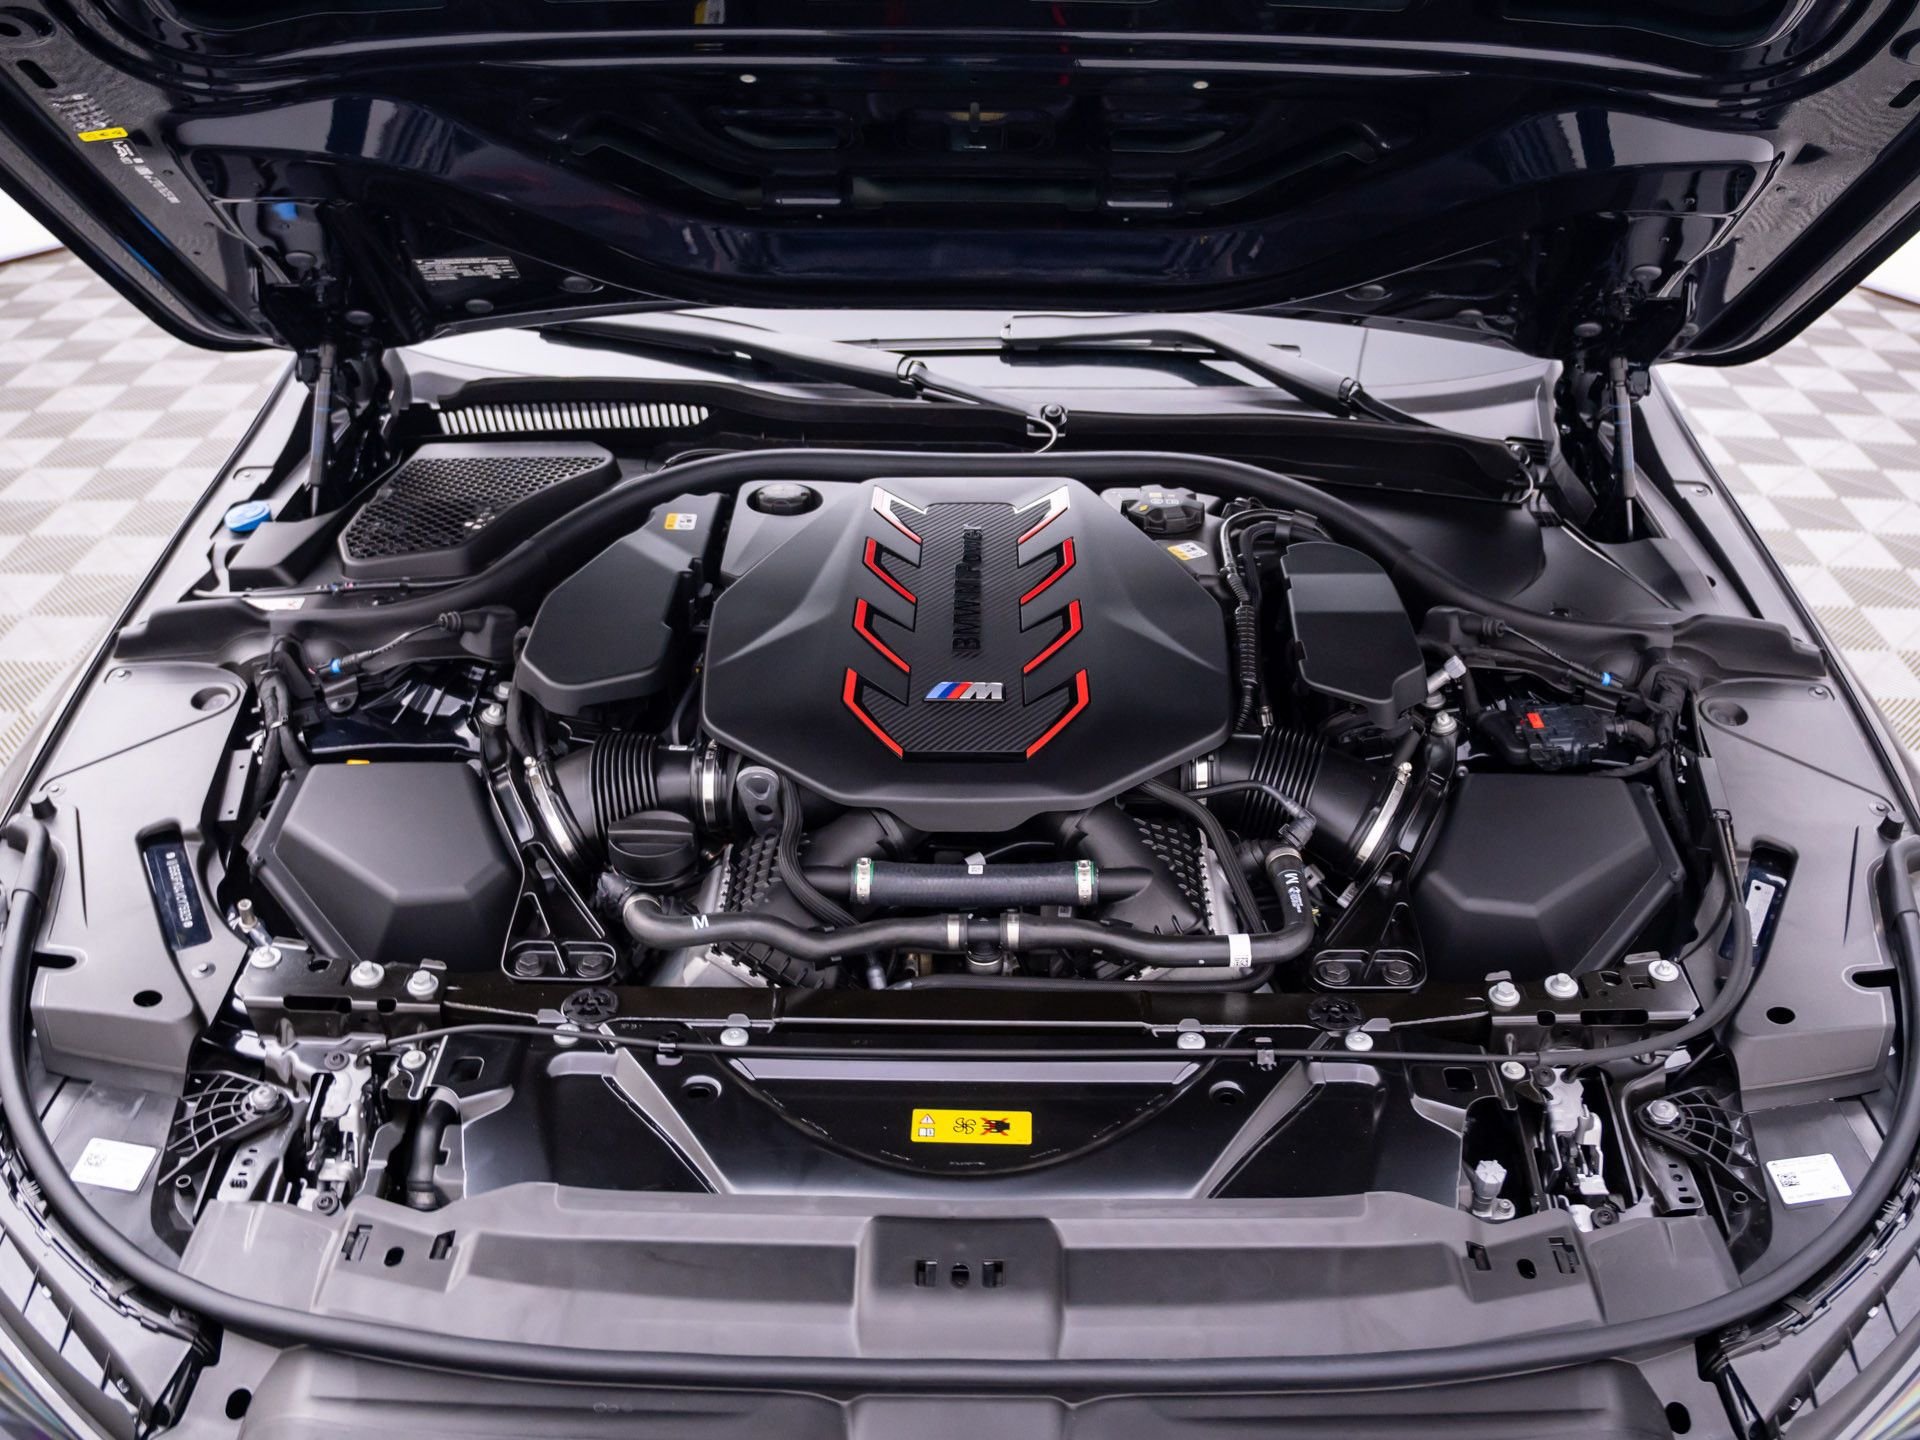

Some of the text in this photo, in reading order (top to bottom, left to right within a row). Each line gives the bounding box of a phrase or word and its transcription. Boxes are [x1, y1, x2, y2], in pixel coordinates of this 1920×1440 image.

[952, 600, 981, 650] BMW
[957, 681, 1005, 700] M
[692, 915, 709, 930] M
